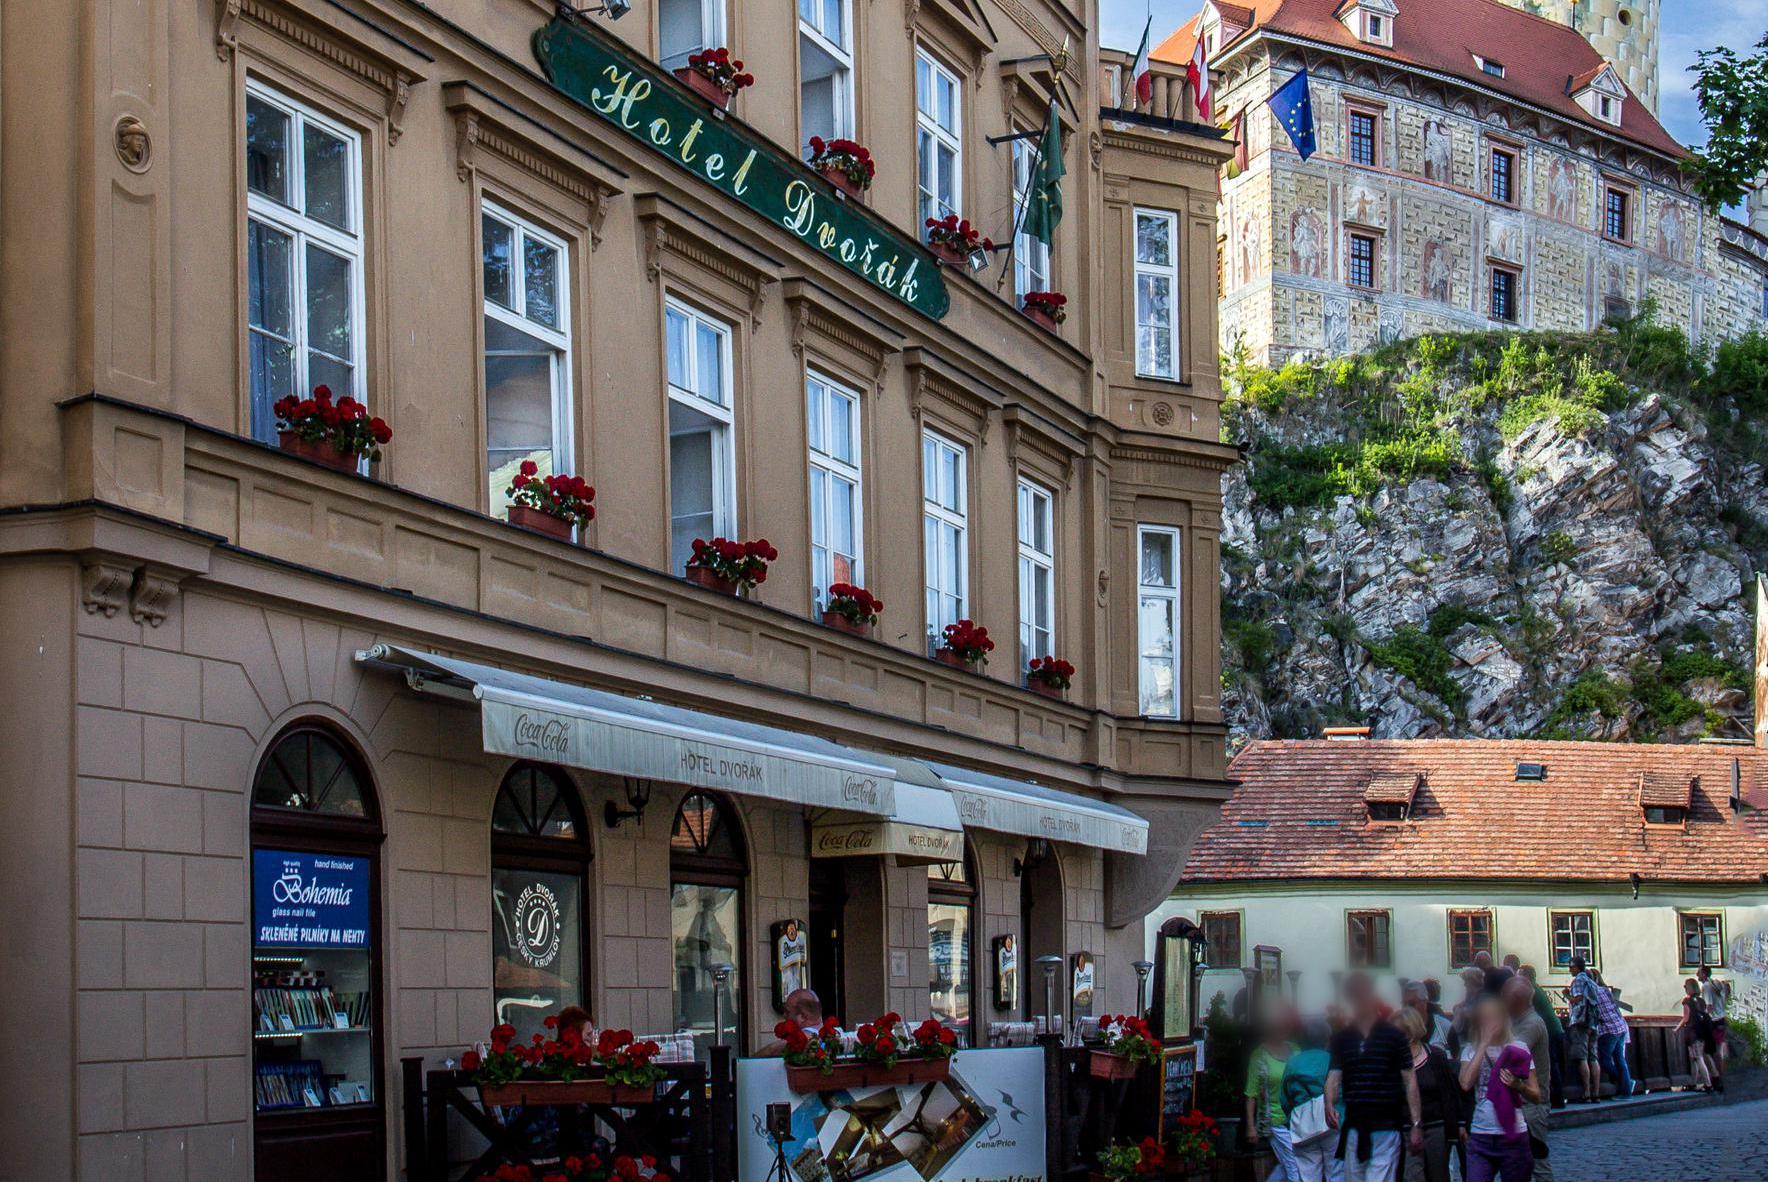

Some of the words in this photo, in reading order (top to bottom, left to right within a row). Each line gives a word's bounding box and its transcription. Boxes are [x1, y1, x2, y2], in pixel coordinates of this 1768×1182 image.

[591, 64, 757, 196] Hotel
[783, 180, 919, 303] Dvořák
[681, 752, 717, 775] HOTEL
[720, 759, 763, 781] DVOŘÁK
[908, 834, 926, 847] HOTEL
[314, 859, 330, 869] hand
[330, 860, 354, 871] finished
[273, 873, 353, 906] Bohemia
[516, 885, 533, 917] HOTEL
[272, 907, 291, 918] glass
[291, 908, 304, 917] nail
[260, 923, 299, 942] SKLENĚNÉ
[300, 924, 329, 943] PILNÍKY
[330, 928, 340, 943] NA
[342, 929, 366, 944] NEHTY
[975, 1139, 1017, 1149] Cena/Price
